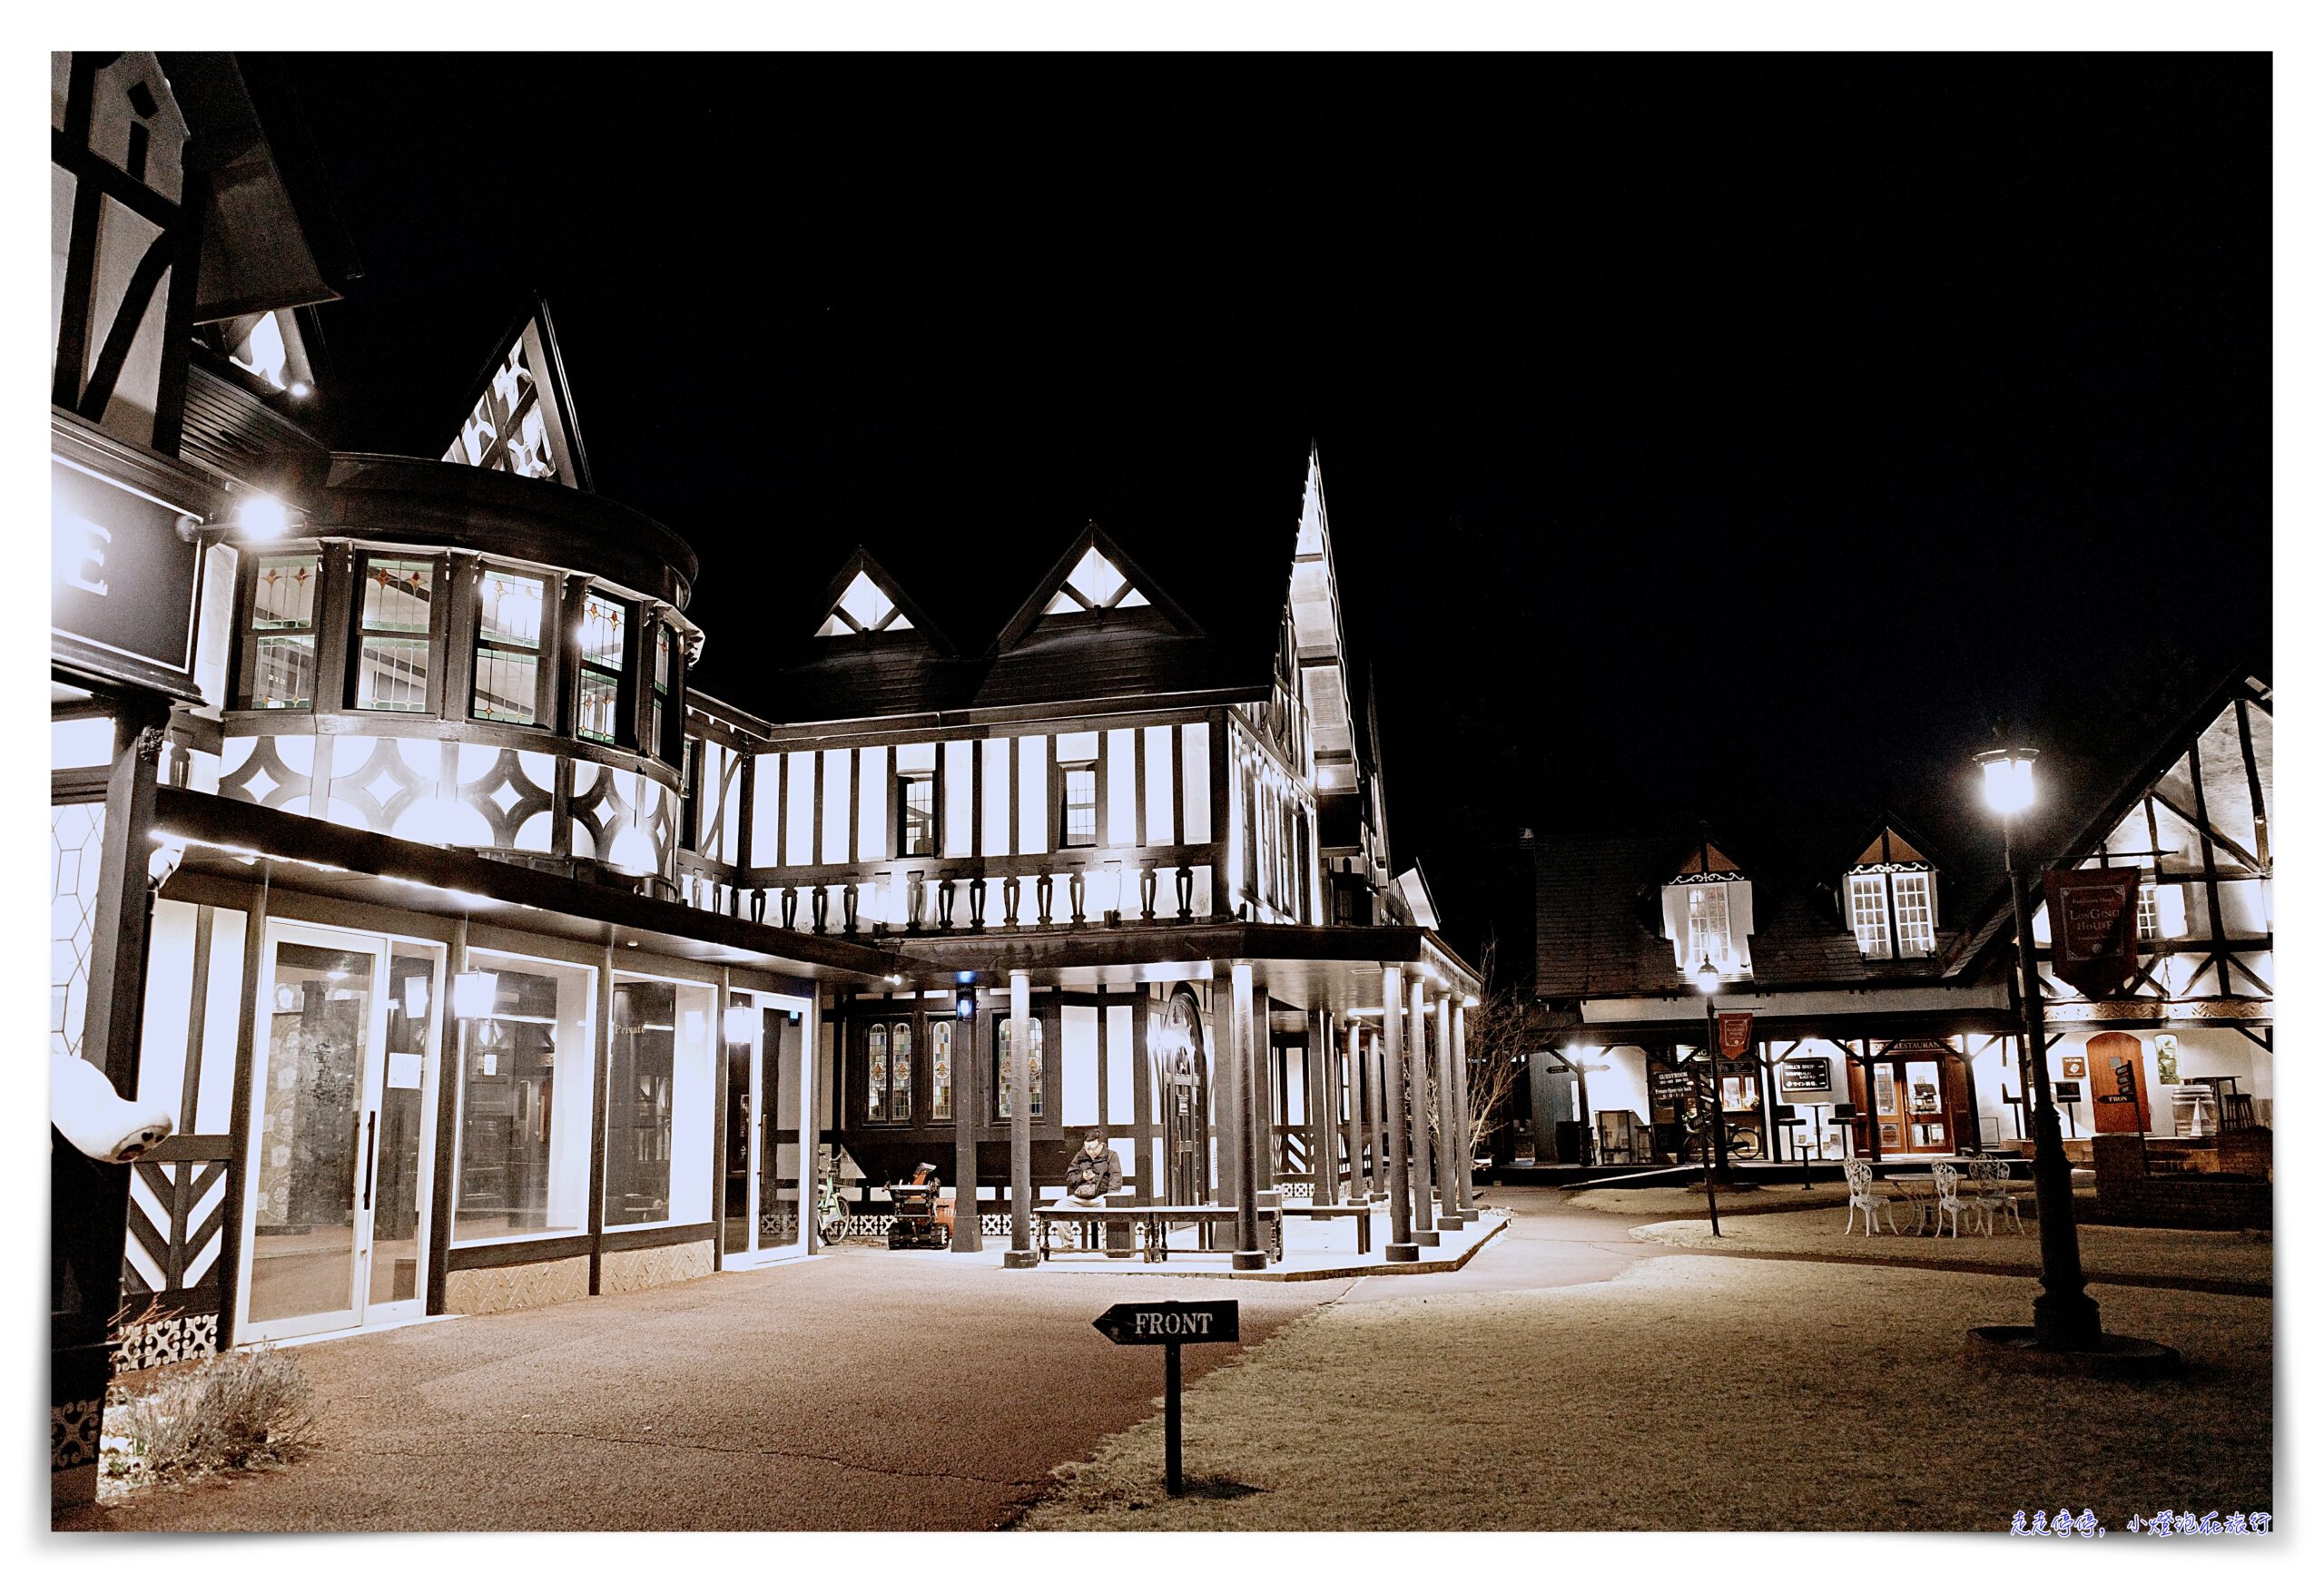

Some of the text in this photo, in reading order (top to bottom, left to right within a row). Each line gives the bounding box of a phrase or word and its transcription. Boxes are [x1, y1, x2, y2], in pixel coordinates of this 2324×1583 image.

[615, 1024, 645, 1034] Private
[1894, 1041, 1941, 1049] RESTAURAN
[1135, 1313, 1213, 1335] FRONT
